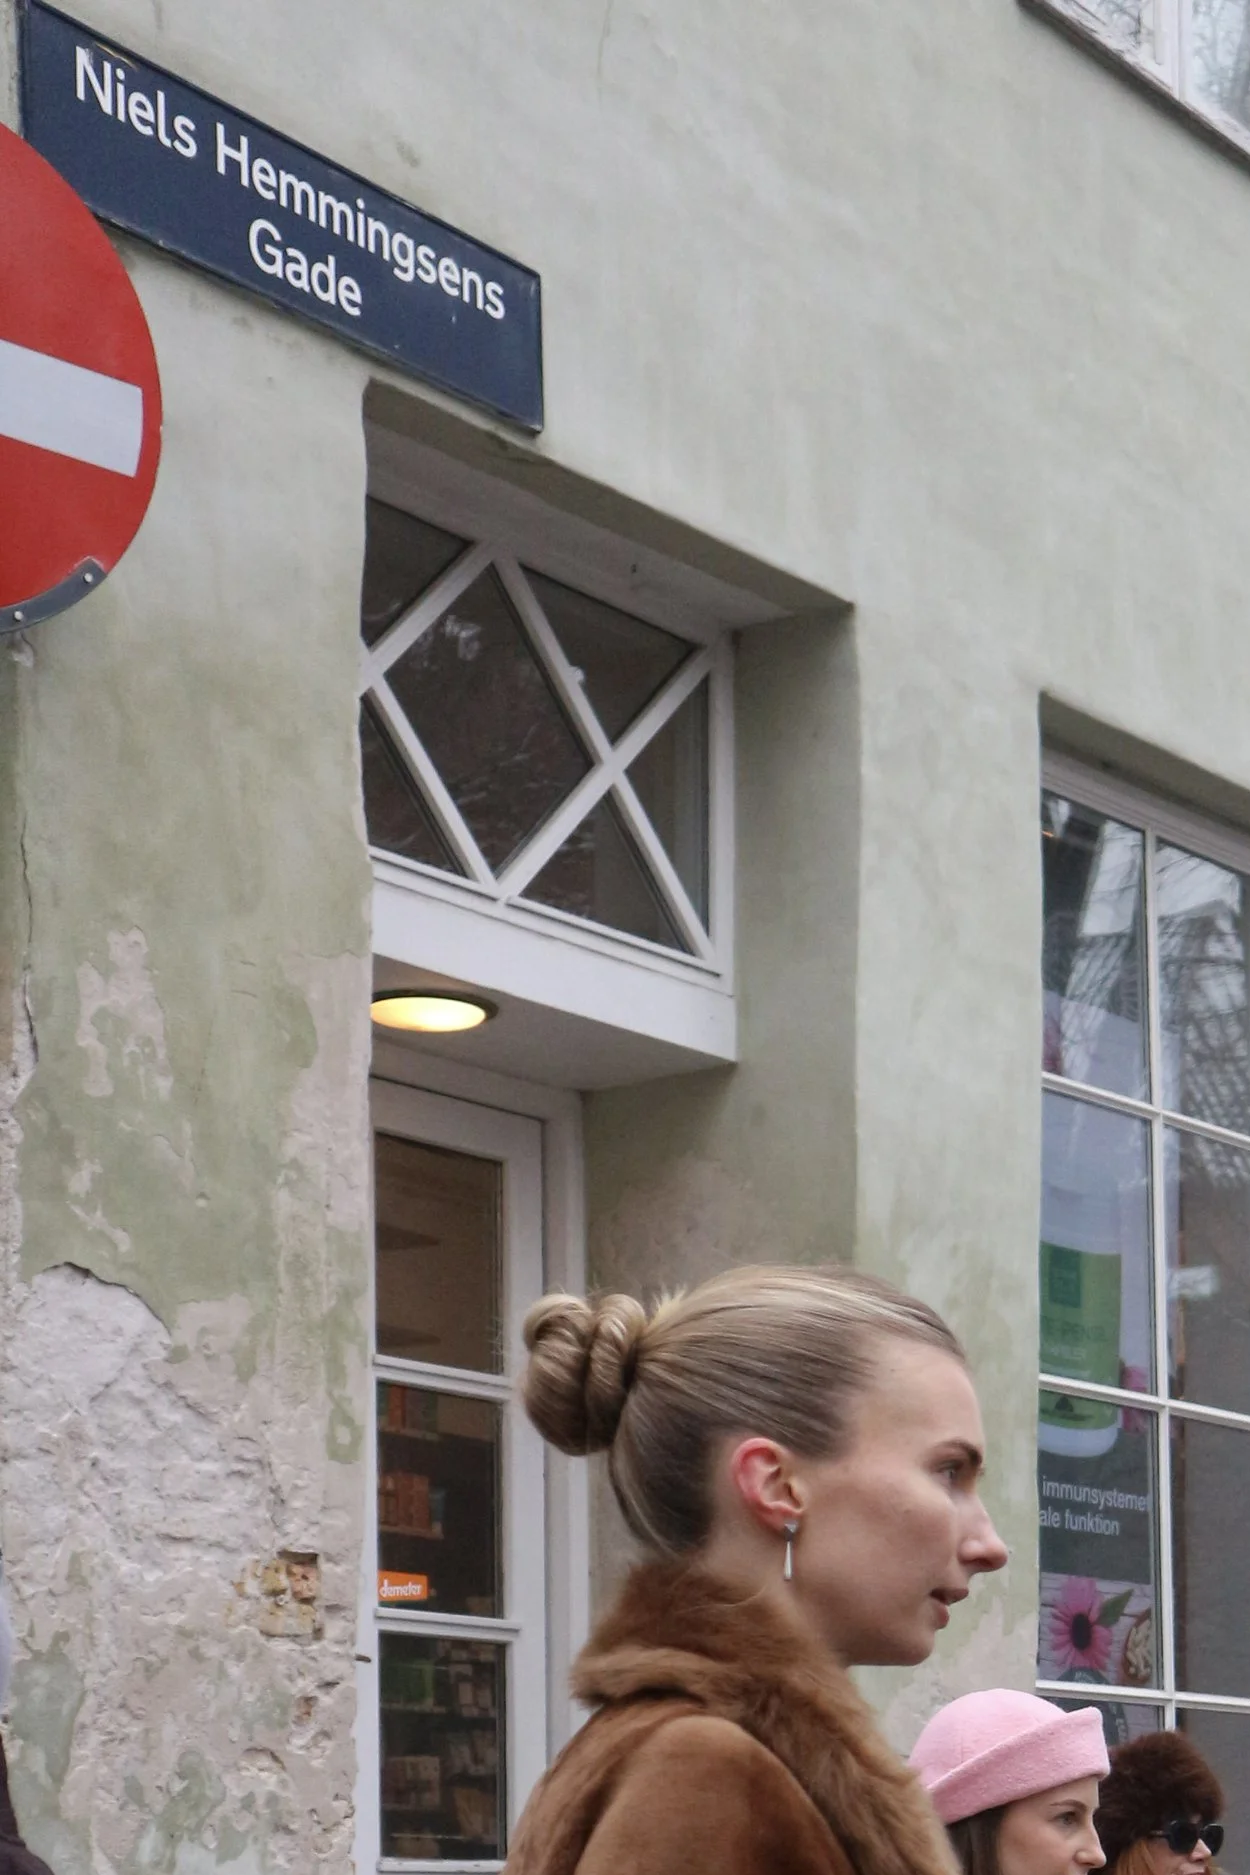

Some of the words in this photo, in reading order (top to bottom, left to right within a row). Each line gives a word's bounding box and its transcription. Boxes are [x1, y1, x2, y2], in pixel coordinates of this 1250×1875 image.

[76, 45, 198, 158] Niels
[215, 122, 506, 320] Hemmingsens
[249, 218, 363, 316] Gade
[1064, 1508, 1120, 1536] funktion
[379, 1579, 422, 1598] demeter
